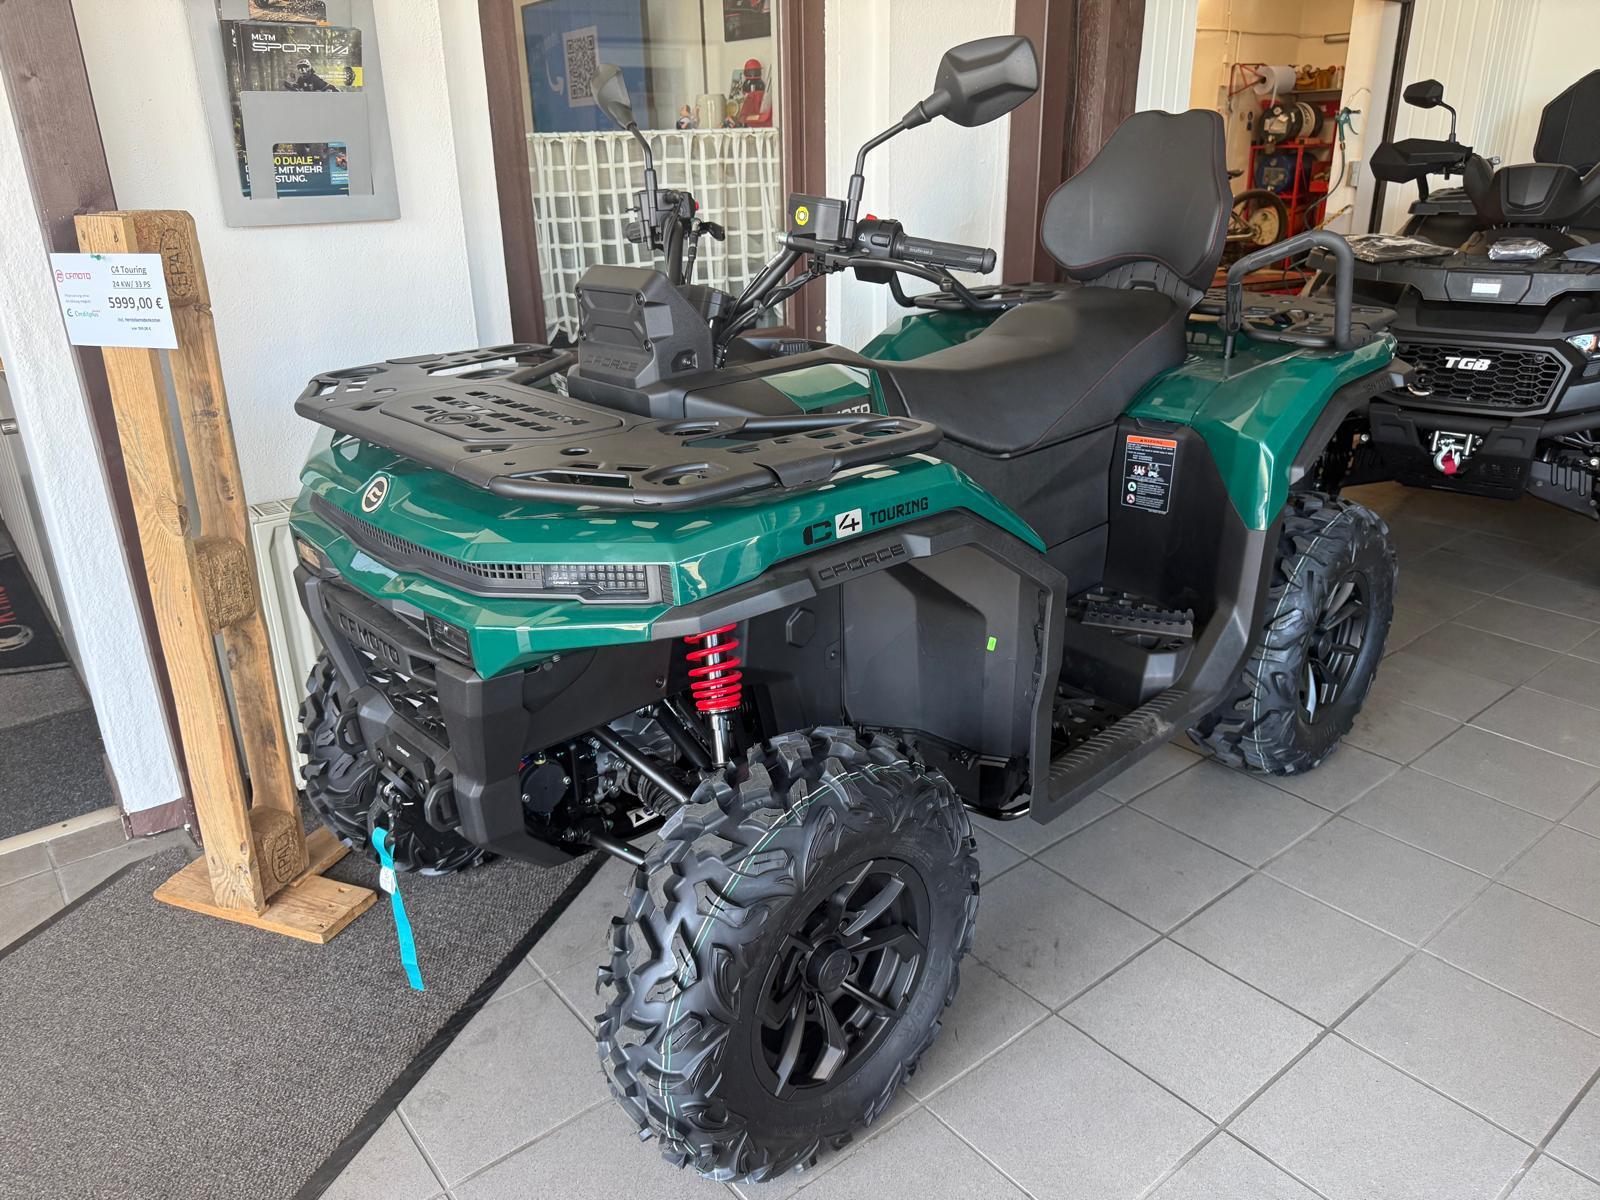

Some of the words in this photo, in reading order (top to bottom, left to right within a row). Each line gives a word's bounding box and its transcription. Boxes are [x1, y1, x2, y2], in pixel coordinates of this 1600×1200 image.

[251, 33, 276, 41] MLTM
[251, 42, 349, 55] SPORTIVA
[279, 166, 295, 174] MIT
[296, 165, 323, 174] MEHR
[110, 265, 120, 274] C4
[121, 265, 147, 275] Touring
[112, 280, 120, 288] 24
[143, 280, 151, 288] PS
[108, 296, 153, 311] 5999,00
[155, 297, 164, 309] €
[1445, 356, 1492, 371] TGB
[869, 496, 929, 526] TOURING
[817, 543, 906, 581] CFORCE
[337, 612, 400, 665] CFMOTO
